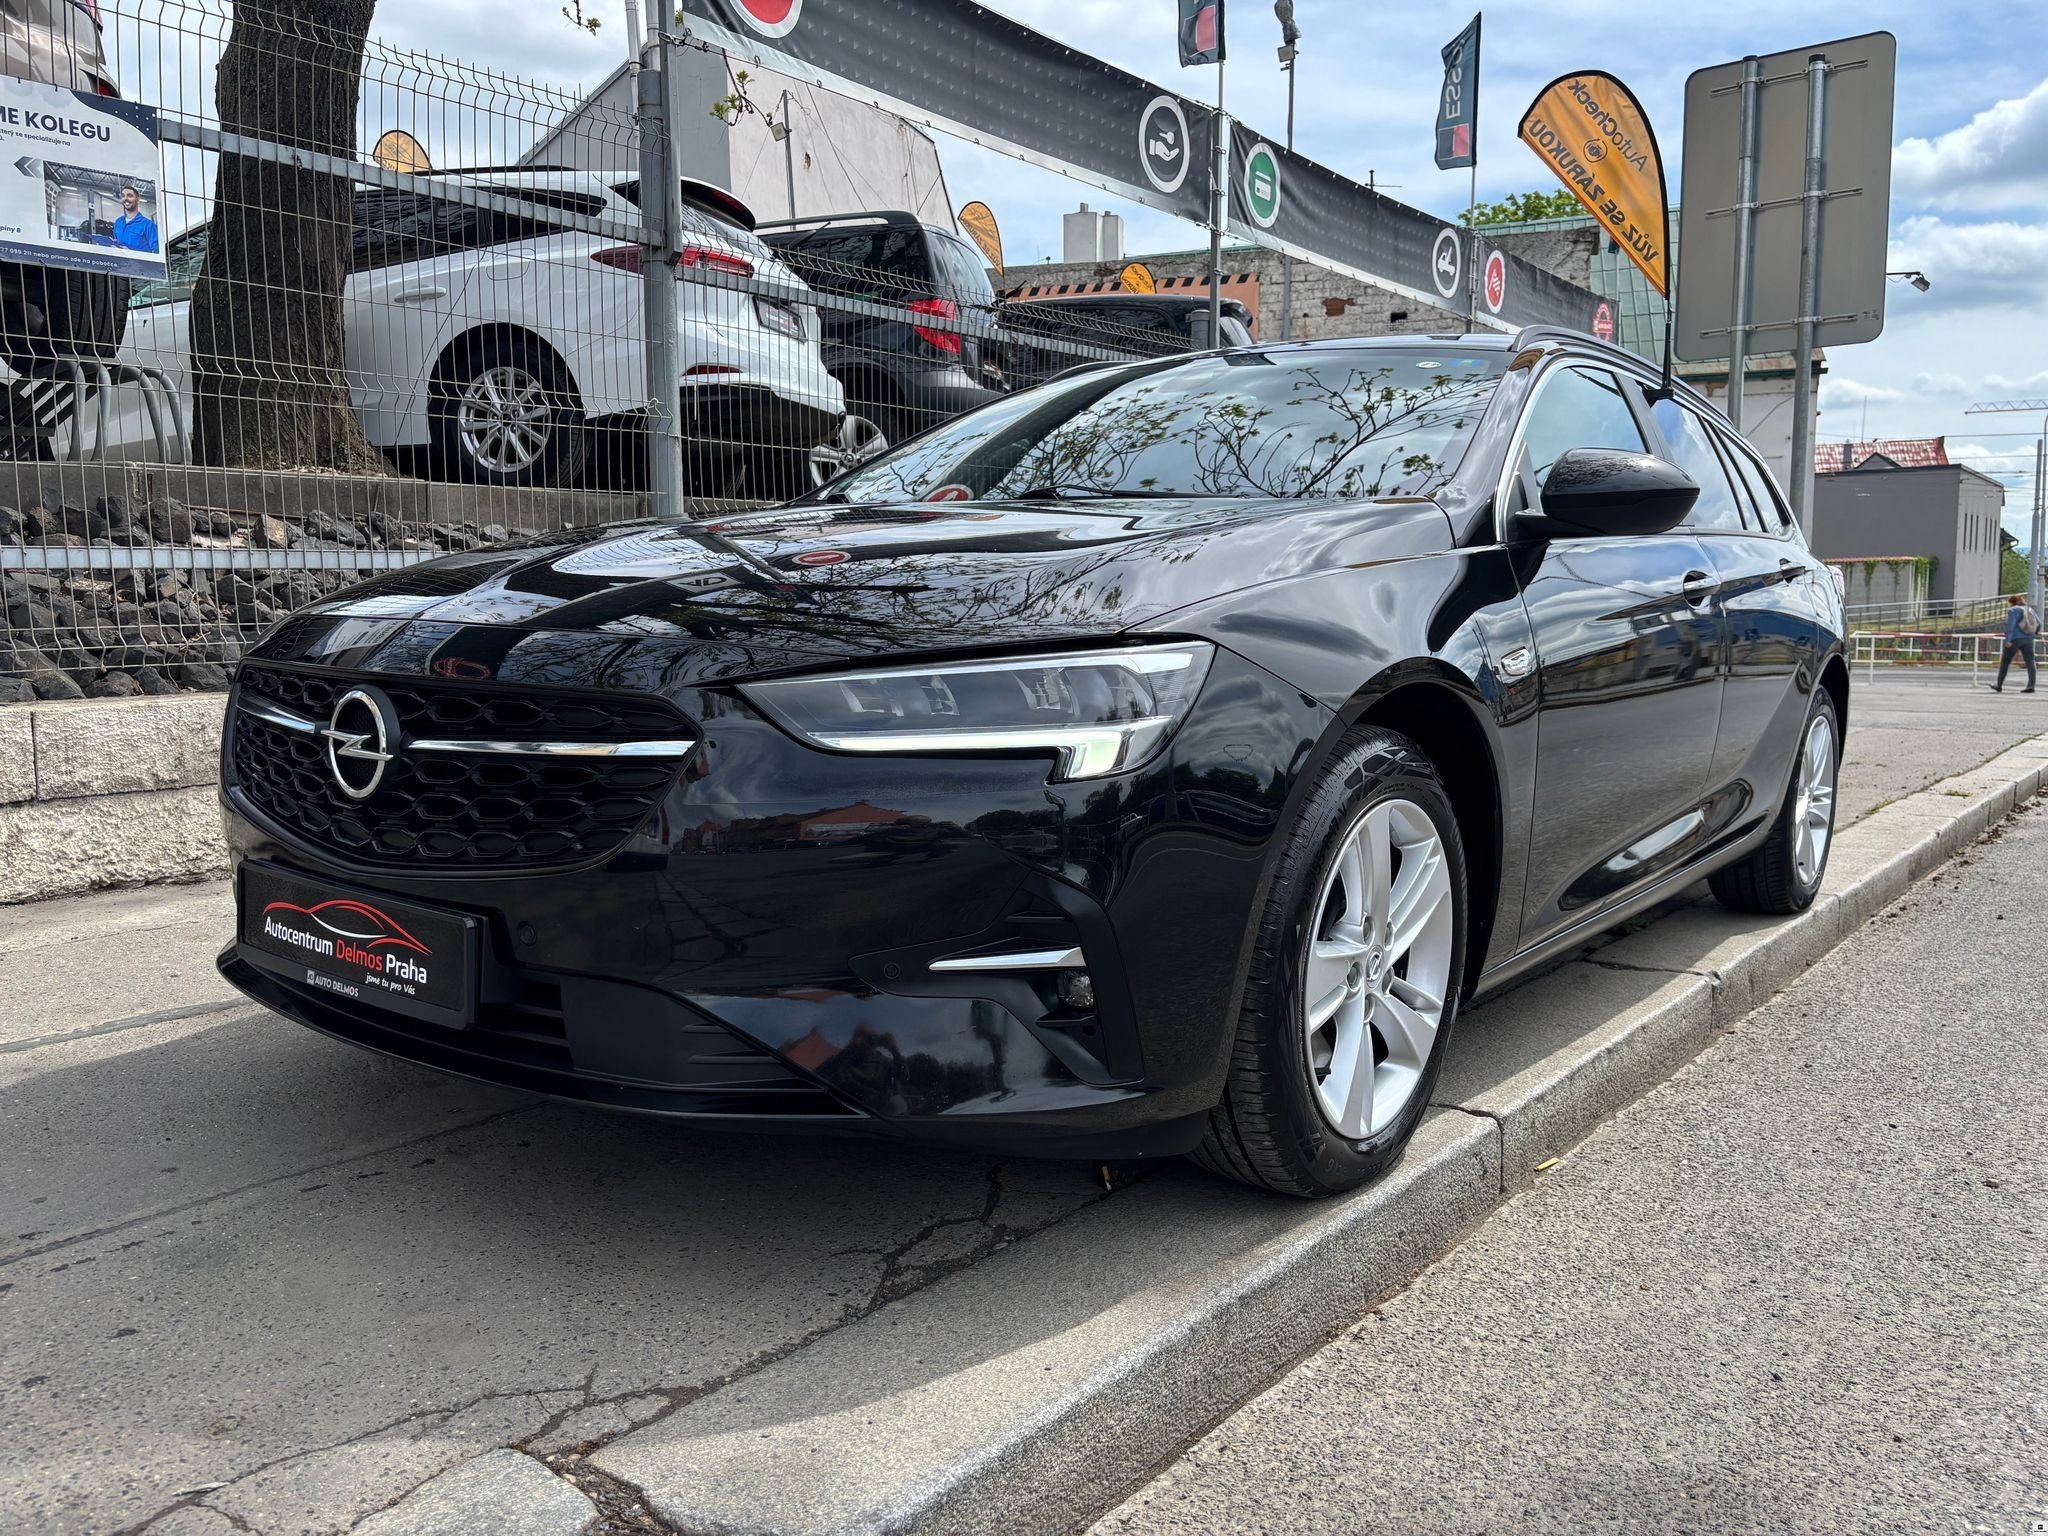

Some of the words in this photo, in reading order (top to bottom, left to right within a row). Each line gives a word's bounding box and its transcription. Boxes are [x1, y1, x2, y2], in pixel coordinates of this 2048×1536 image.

[0, 129, 14, 137] terý
[24, 133, 61, 145] specializuje
[25, 110, 110, 142] KOLEGU
[264, 916, 333, 956] Autocentrum
[336, 939, 383, 972] Delmos
[386, 953, 427, 984] Praha
[315, 975, 332, 988] AUTO
[332, 980, 359, 997] DELMOS
[365, 972, 380, 984] jsme
[381, 978, 389, 988] tu
[390, 982, 402, 991] pro
[403, 984, 416, 995] Vás
